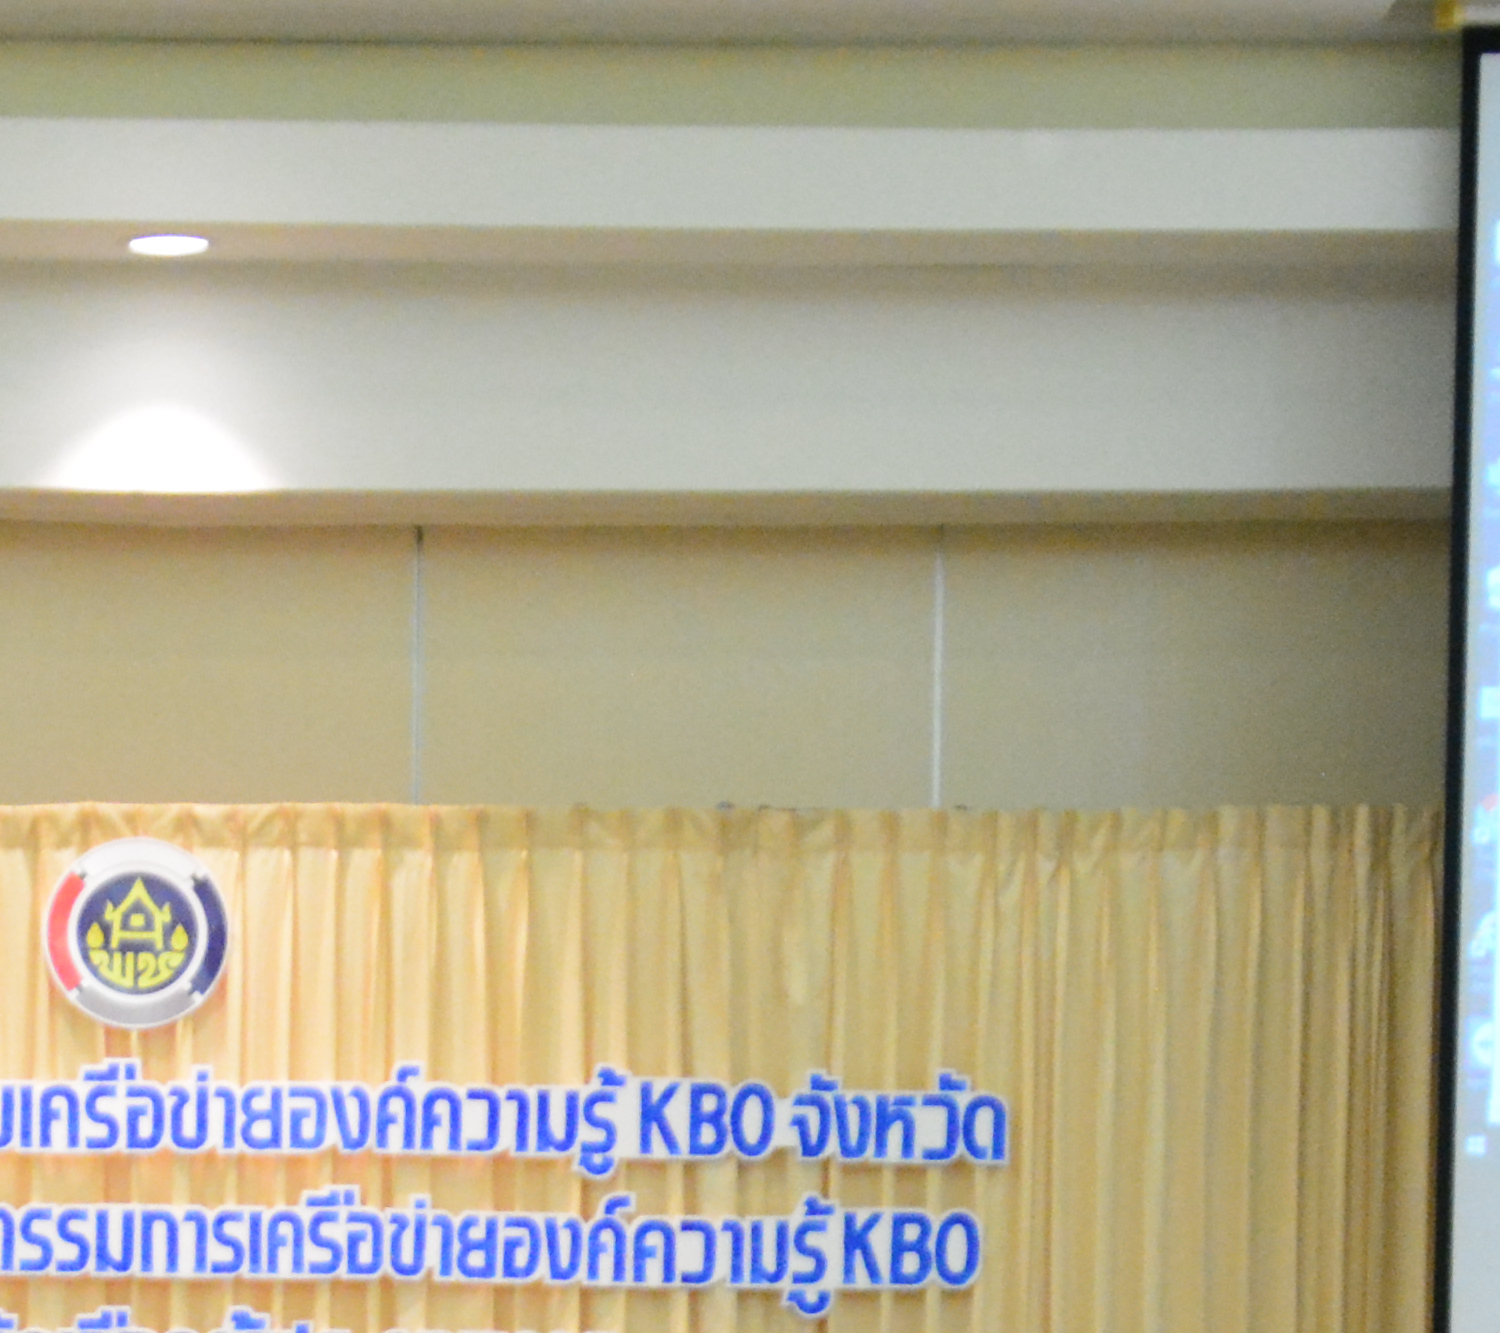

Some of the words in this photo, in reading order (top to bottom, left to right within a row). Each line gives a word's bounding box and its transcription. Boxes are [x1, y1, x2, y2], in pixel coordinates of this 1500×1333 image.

[639, 1081, 776, 1158] KBO
[789, 1073, 1007, 1161] จังหวัด
[842, 1212, 981, 1287] KBO
